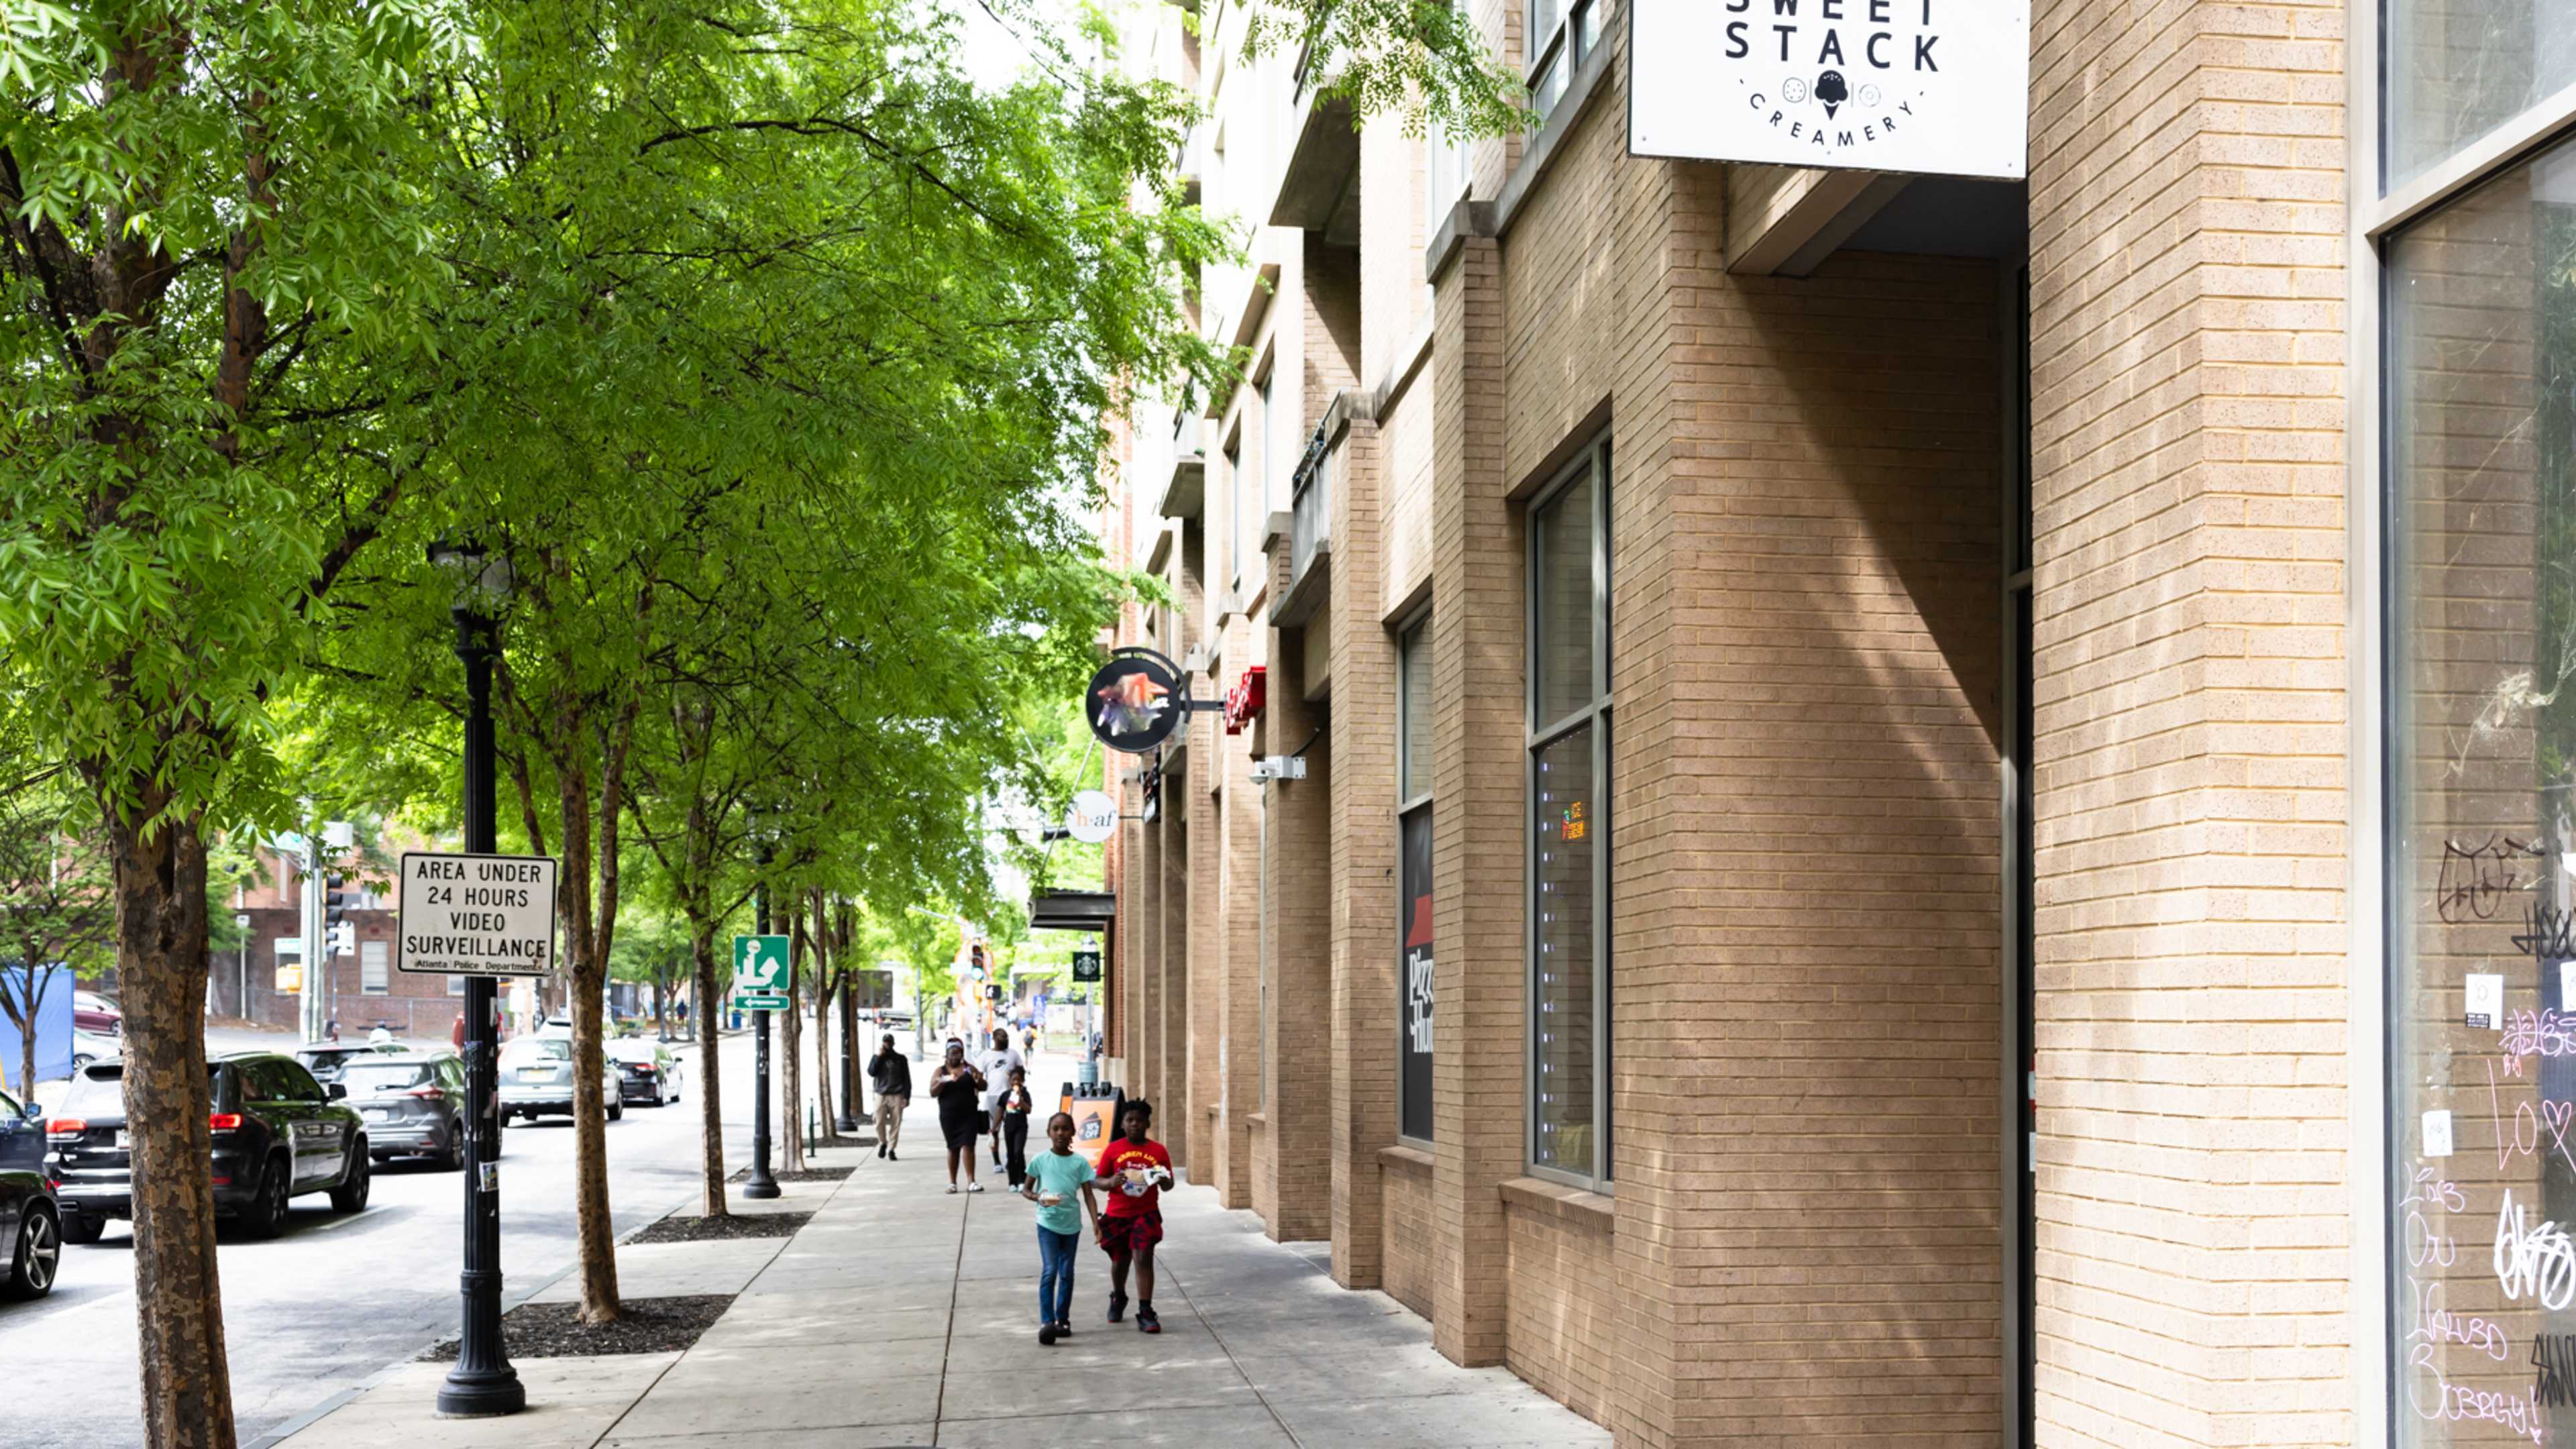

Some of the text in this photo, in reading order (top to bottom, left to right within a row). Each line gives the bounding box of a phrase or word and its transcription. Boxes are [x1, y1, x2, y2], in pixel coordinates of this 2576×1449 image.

[1725, 21, 1939, 72] STACK
[1750, 93, 1913, 146] CREAMERY
[417, 861, 541, 883] AREA UNDER
[427, 886, 529, 907] 24 HOURS
[450, 912, 505, 931] VIDEO
[406, 935, 546, 957] SURVEILLANCE
[416, 959, 537, 971] Atlanta Police Department
[1409, 948, 1433, 1006] Pizz
